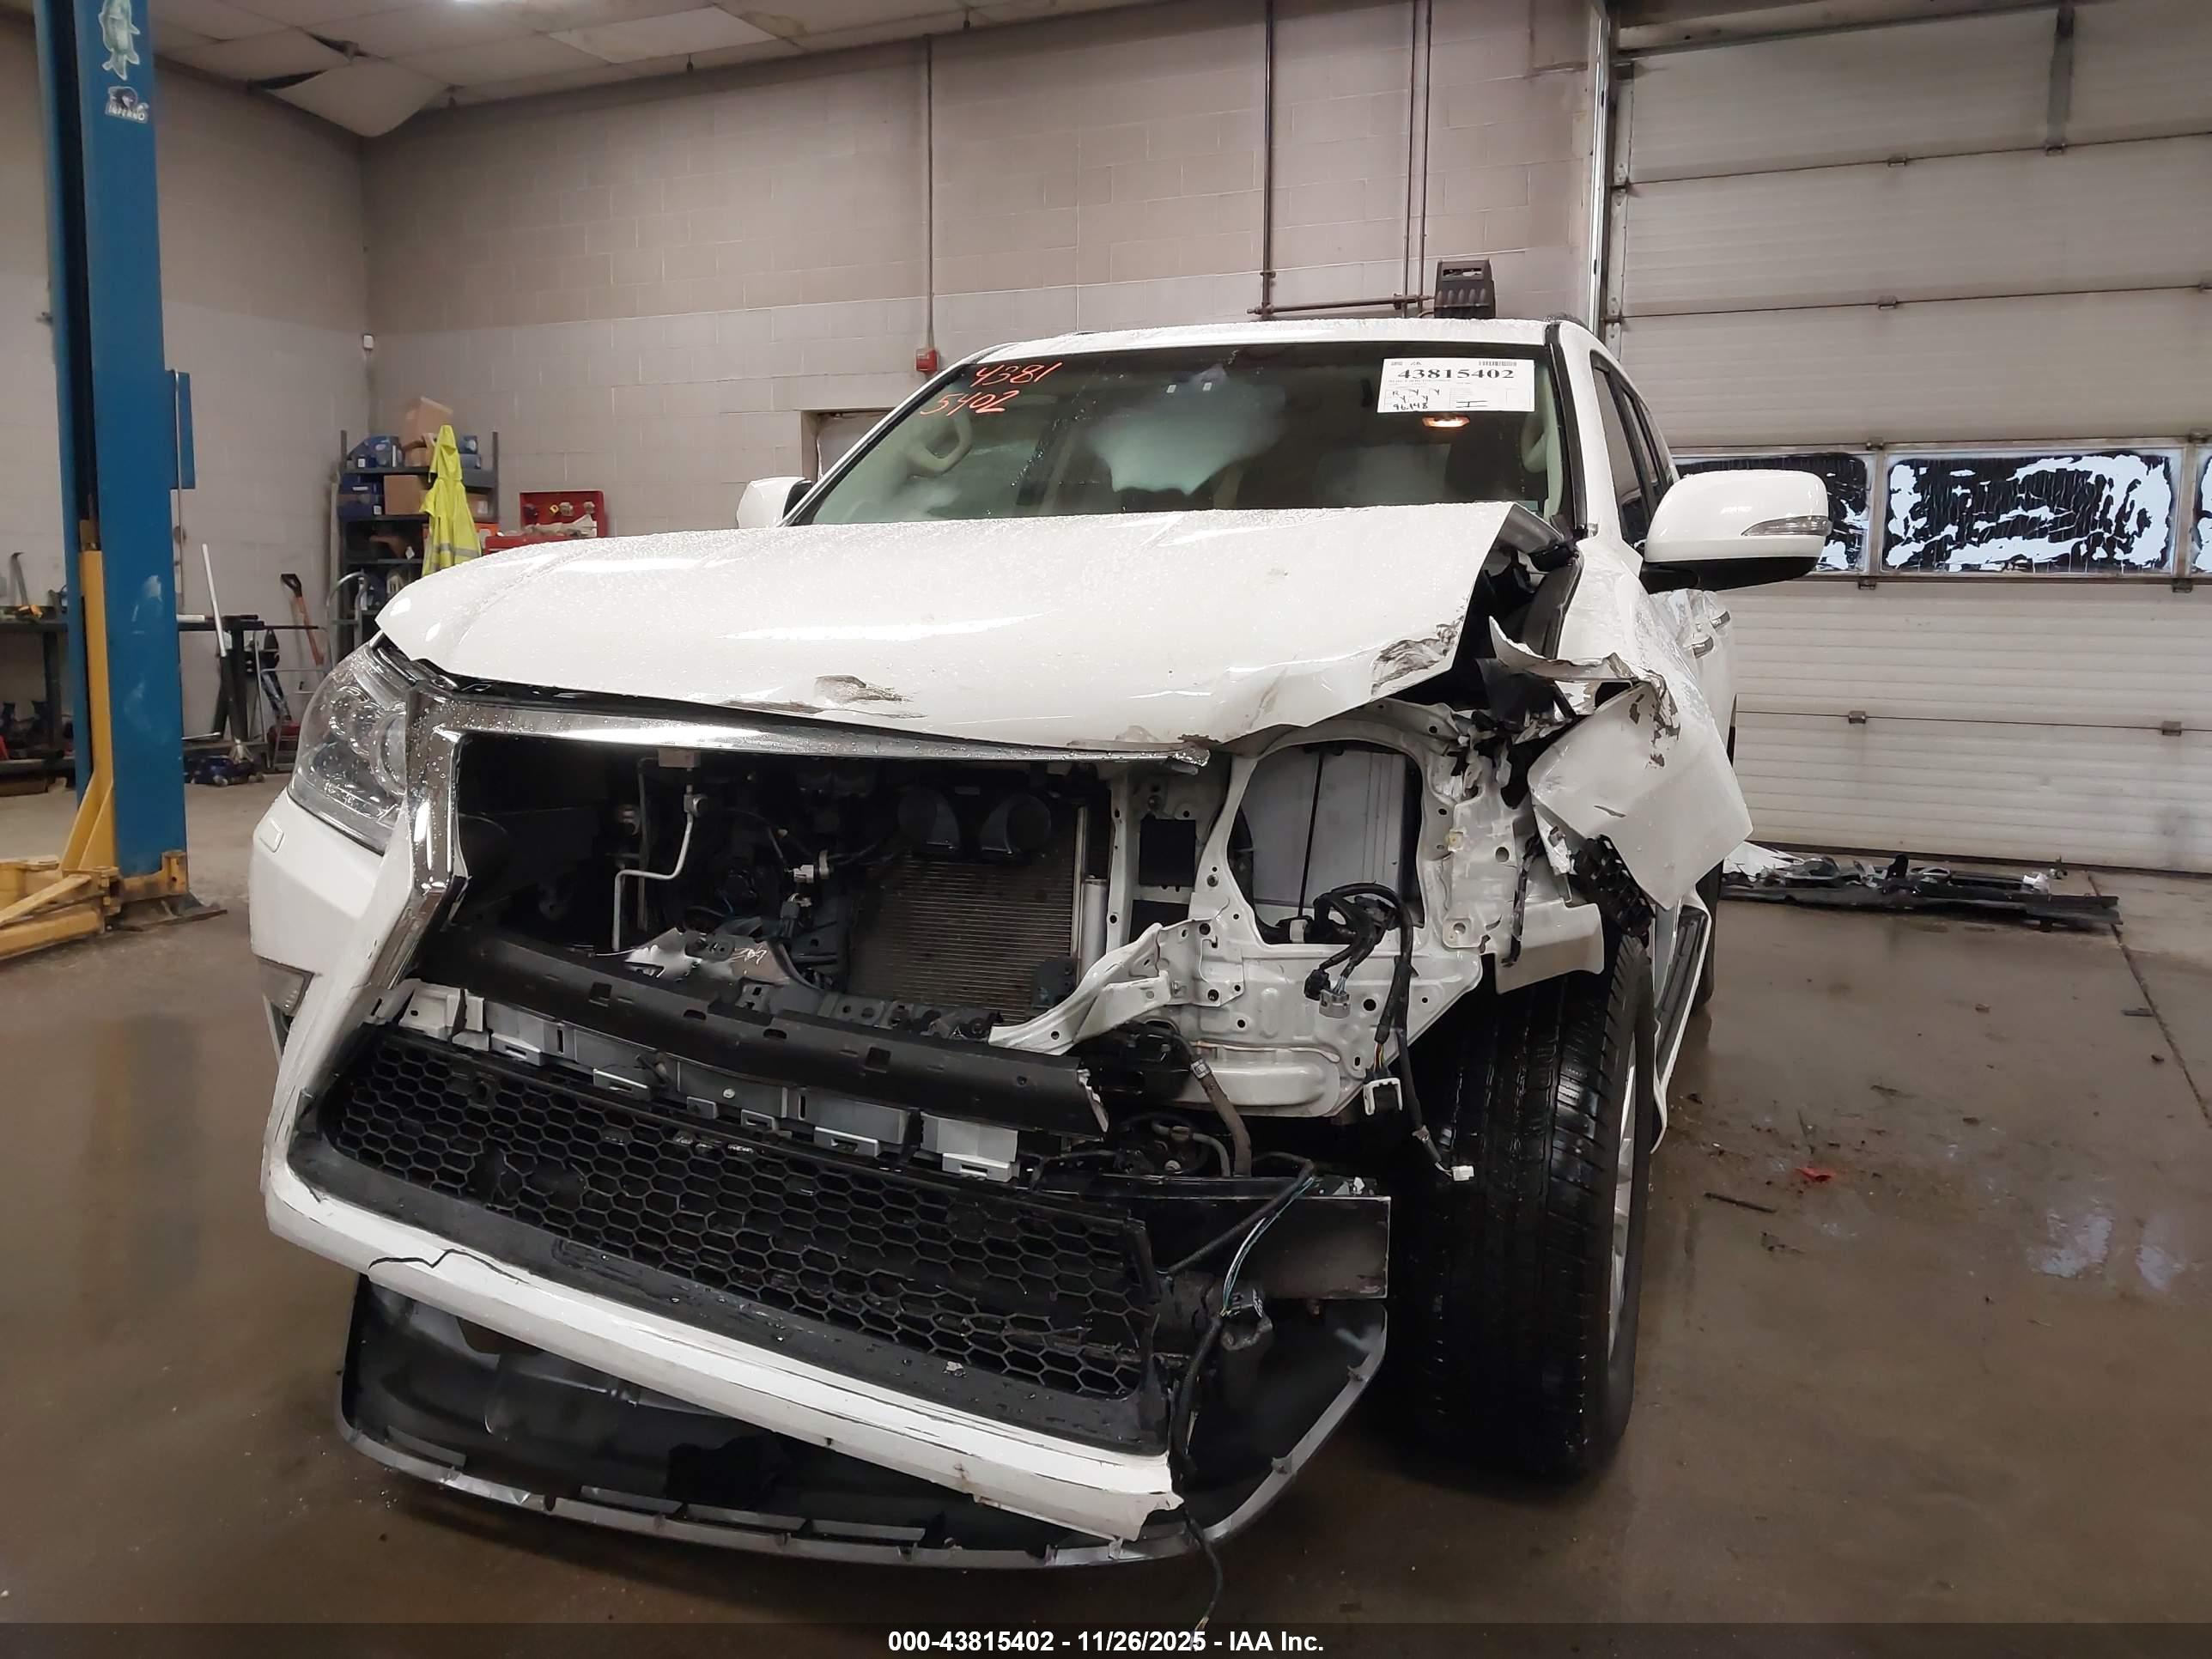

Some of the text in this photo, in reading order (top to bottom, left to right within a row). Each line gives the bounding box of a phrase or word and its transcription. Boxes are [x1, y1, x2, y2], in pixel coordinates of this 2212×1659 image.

[970, 362, 1063, 388] 4381
[1398, 368, 1515, 380] 43815402
[920, 390, 1020, 416] 5402
